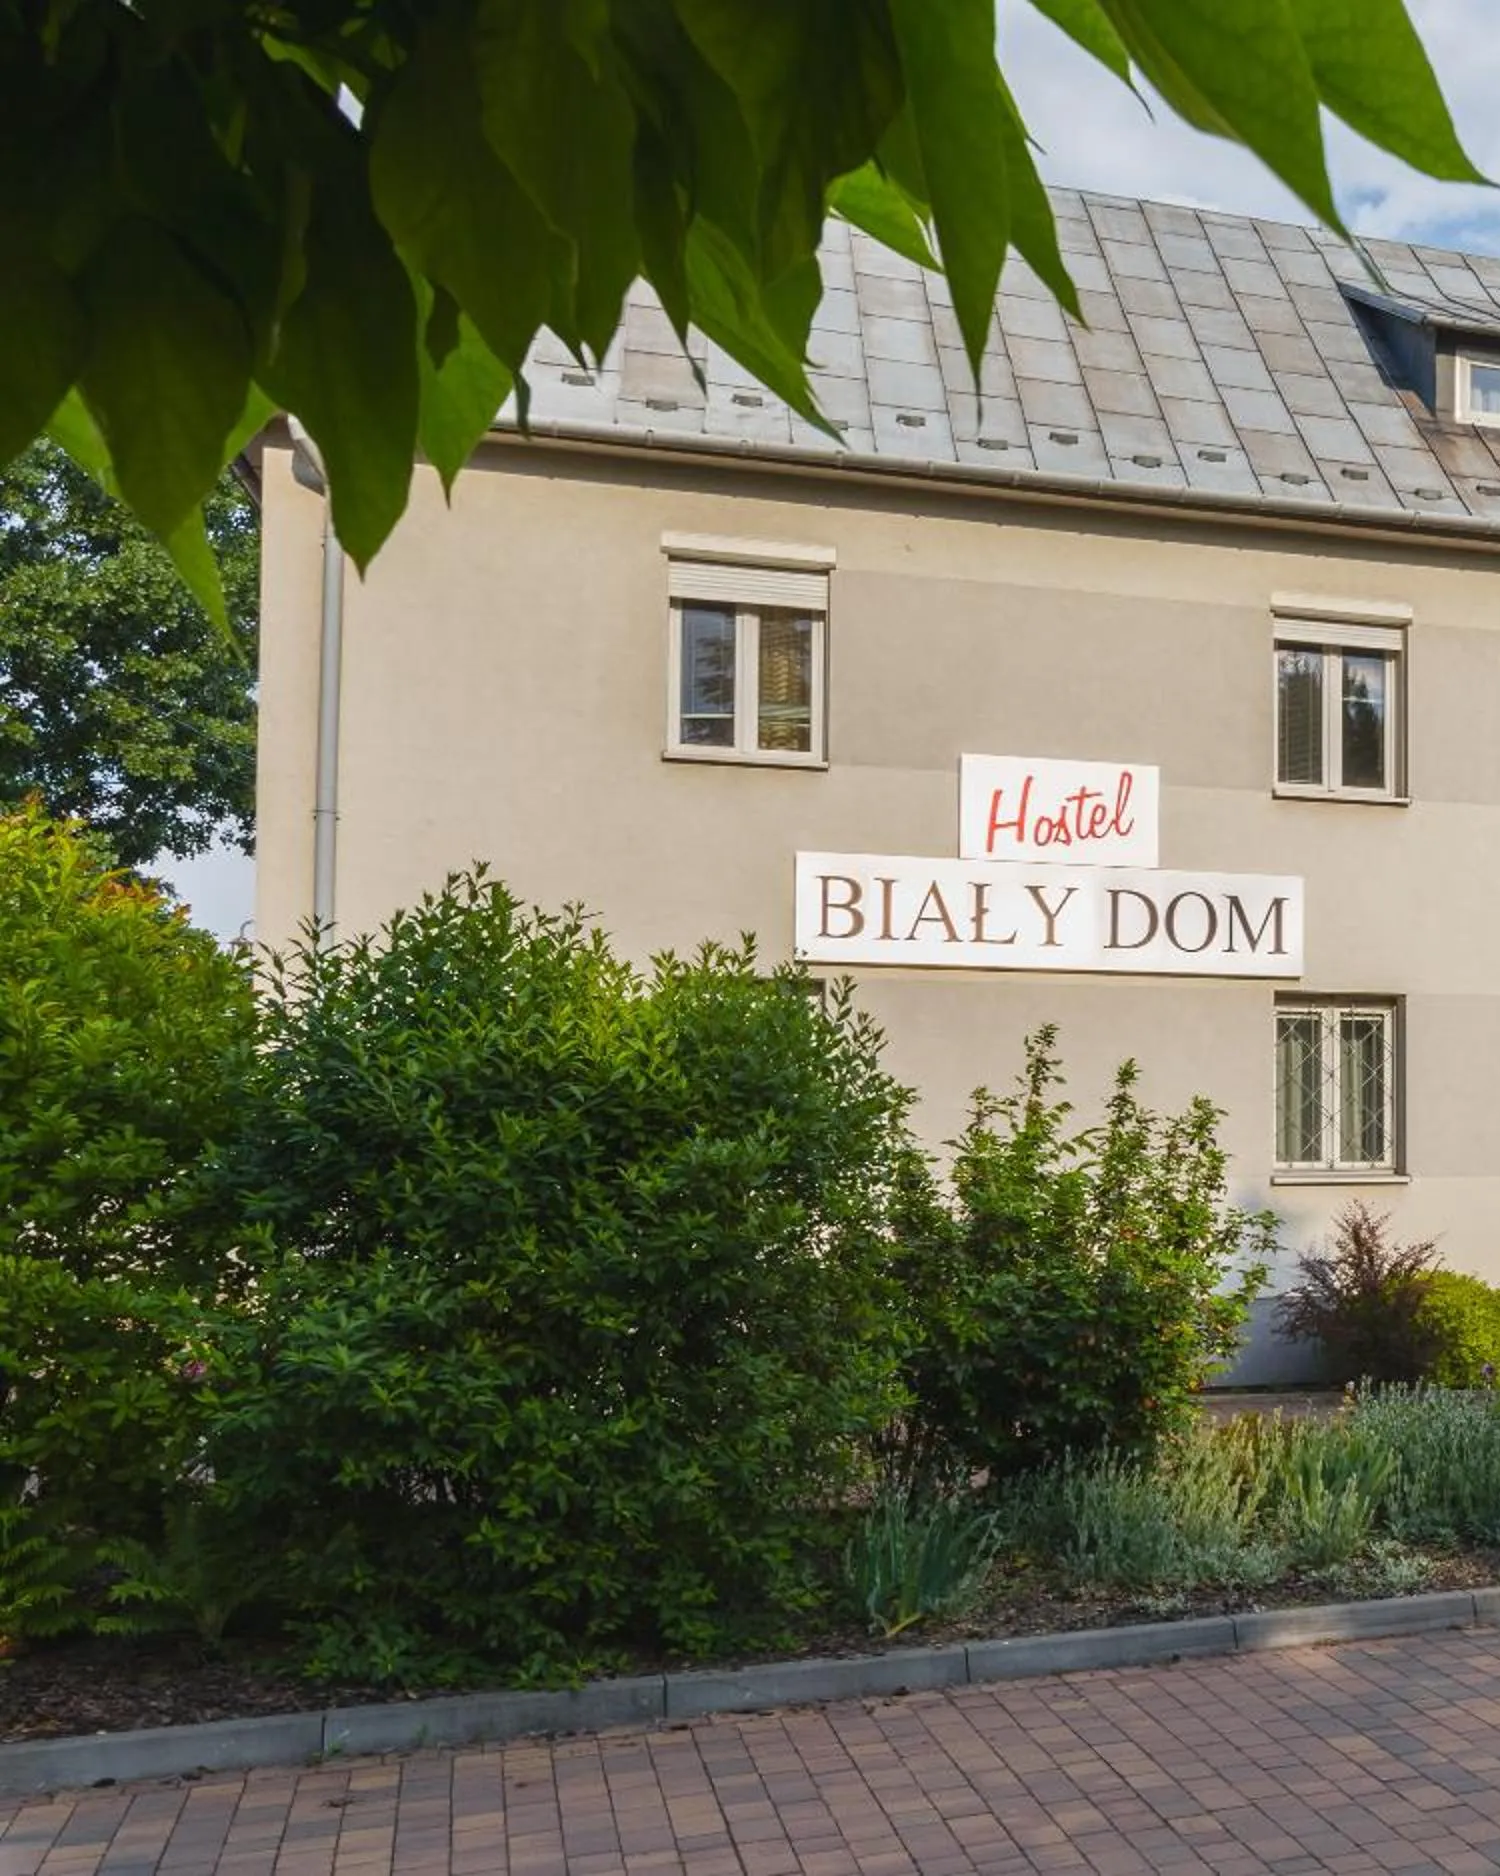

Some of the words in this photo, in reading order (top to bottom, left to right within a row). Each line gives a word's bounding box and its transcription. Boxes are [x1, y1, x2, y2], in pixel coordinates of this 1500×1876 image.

[985, 770, 1134, 853] Hostel
[815, 875, 1080, 948] BIAŁY
[1103, 889, 1290, 955] DOM
